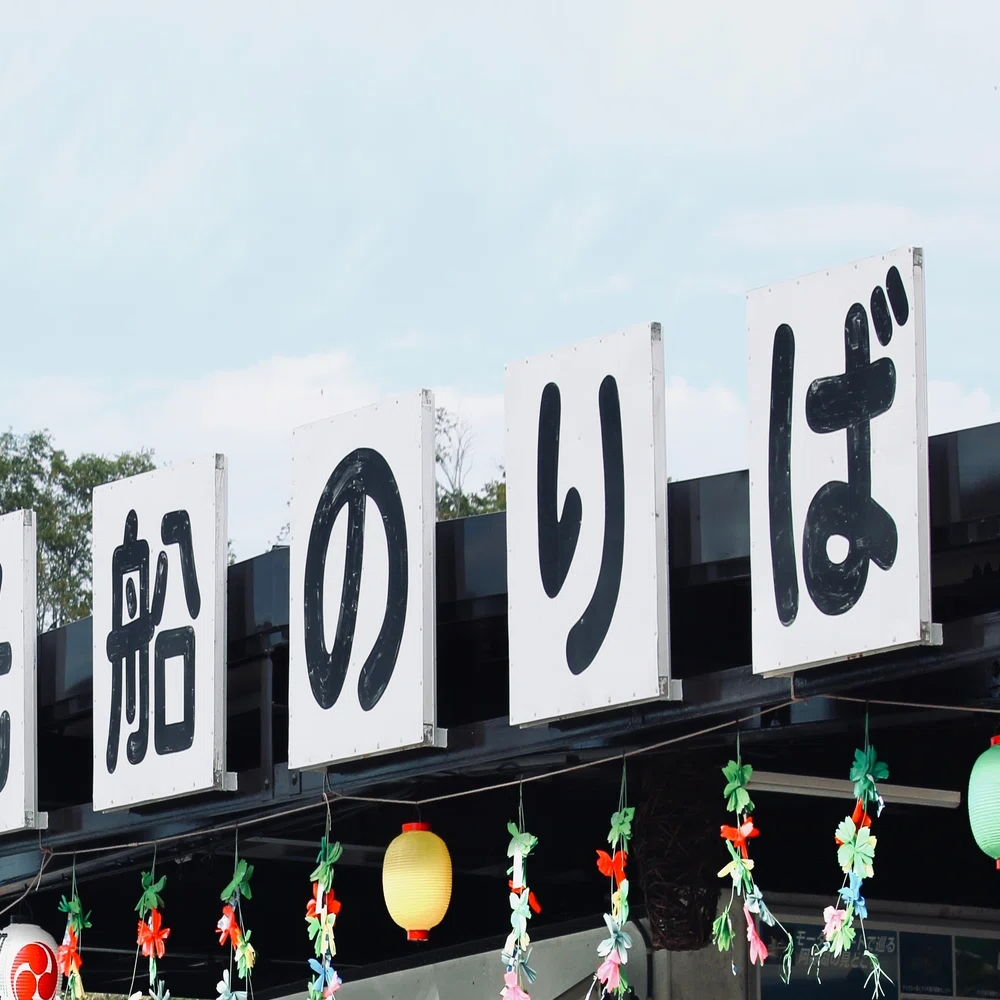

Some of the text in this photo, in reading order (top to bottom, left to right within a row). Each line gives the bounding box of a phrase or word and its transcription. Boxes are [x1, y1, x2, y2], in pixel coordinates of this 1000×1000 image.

[796, 931, 896, 953] モータトで巡る
